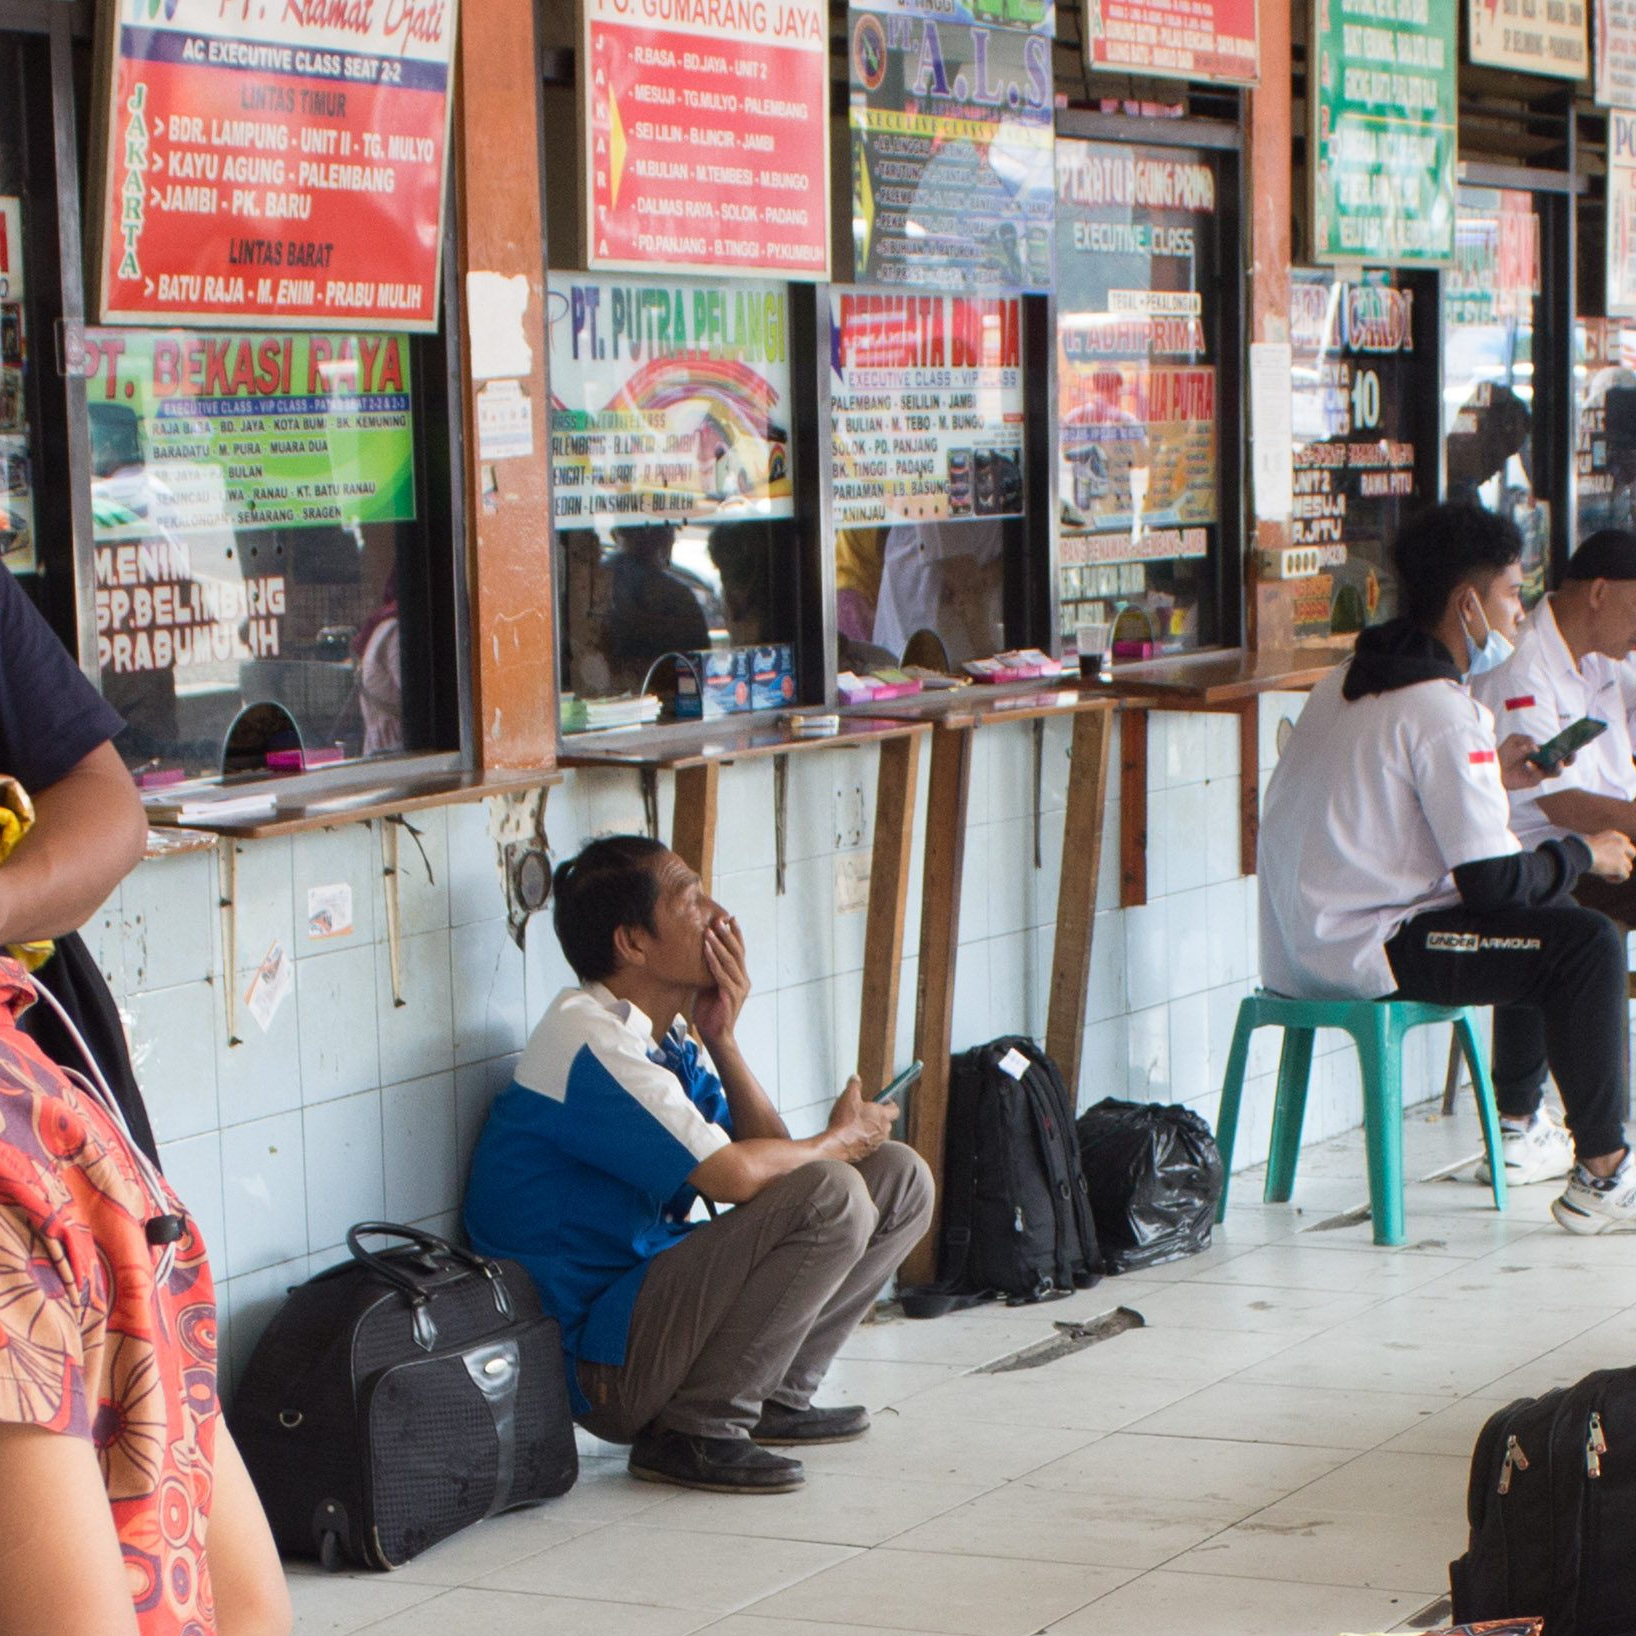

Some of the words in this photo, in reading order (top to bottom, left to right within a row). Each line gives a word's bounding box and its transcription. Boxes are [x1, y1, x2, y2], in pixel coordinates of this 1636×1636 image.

[772, 3, 825, 43] JAYA
[182, 38, 205, 60] AC
[208, 42, 292, 71] EXECUTIVE
[295, 50, 341, 76] CLASS
[343, 54, 379, 80] SEAT
[381, 59, 402, 83] 2-2
[634, 46, 677, 67] R.BASA
[683, 52, 729, 74] BD.JAYA
[735, 57, 759, 77] UNIT
[240, 84, 296, 115] LINTAS
[300, 90, 347, 119] TIMUR
[683, 89, 738, 112] TG.MULYO
[744, 96, 809, 120] PALEMBANG
[169, 117, 208, 144] BDR.
[211, 120, 288, 152] LAMPUNG
[301, 128, 337, 154] UNIT
[363, 133, 386, 158] TG.
[389, 134, 436, 163] MULYO
[594, 36, 610, 257] JAKARTA
[635, 122, 654, 140] SEI
[656, 125, 683, 142] LILIN
[742, 132, 775, 153] JAMBI
[117, 83, 148, 278] JAKARTA
[168, 154, 218, 181] KAYU
[222, 156, 286, 187] AGUNG
[298, 162, 395, 194] PALEMBANG
[635, 160, 690, 181] M.BULIAN
[696, 165, 754, 187] M.TEMBESI
[760, 169, 810, 191] M.BUNGO
[163, 188, 218, 215] JAMBI
[231, 191, 261, 217] PK.
[265, 193, 312, 221] BARU
[637, 196, 684, 217] DALMAS
[685, 200, 714, 219] RAYA
[720, 202, 758, 223] SOLOK
[765, 206, 809, 227] PADANG
[229, 237, 283, 266] LINTAS
[287, 240, 334, 269] BARAT
[638, 234, 707, 256] PD.PANJANG
[714, 239, 760, 259] B.TINGGI
[1073, 221, 1146, 254] EXECUTIVE
[1151, 225, 1195, 257] CLASS
[158, 274, 199, 304] BATU
[203, 276, 244, 303] RAJA
[257, 278, 273, 305] M.
[276, 278, 314, 305] ENIM
[325, 280, 374, 307] PRABU
[377, 282, 422, 310] MULIH
[569, 285, 606, 361] PT.
[611, 286, 687, 362] PUTRA
[692, 289, 786, 363] PELANGI
[152, 335, 293, 396] BEKASI
[307, 337, 404, 393] RAYA
[849, 371, 911, 388] EXECUTIVE
[915, 370, 952, 387] CLASS
[962, 370, 979, 386] VIP
[221, 400, 252, 414] CLASS
[259, 399, 275, 413] VIP
[277, 398, 307, 412] CLASS
[831, 395, 892, 412] PALEMBANG
[948, 394, 977, 410] JAMBI
[1350, 368, 1381, 431] 10
[220, 420, 238, 434] BD.
[240, 418, 265, 432] JAYA
[273, 417, 301, 431] KOTA
[355, 414, 407, 429] KEMUNING
[846, 415, 884, 433] BULIAN
[891, 416, 902, 431] M.
[905, 415, 931, 431] TEBO
[939, 415, 950, 430] M.
[952, 414, 985, 430] BUNGO
[153, 443, 210, 460] BARADATU
[232, 442, 262, 456] PURA
[269, 440, 306, 455] MUARA
[308, 438, 329, 453] DUA
[874, 439, 890, 454] PD.
[893, 438, 938, 453] PANJANG
[228, 464, 264, 479] BULAN
[833, 463, 850, 478] BK.
[852, 460, 887, 477] TINGGI
[896, 459, 934, 475] PADANG
[252, 486, 288, 501] RANAU
[296, 486, 313, 499] KT.
[313, 483, 339, 498] BATU
[342, 481, 376, 496] RANAU
[833, 483, 884, 499] PARIAMAN
[911, 479, 950, 496] BASUNG
[237, 508, 295, 525] SEMARANG
[301, 506, 342, 520] SRAGEN
[1427, 932, 1478, 951] UNDER
[1480, 936, 1541, 950] ARMOUR
